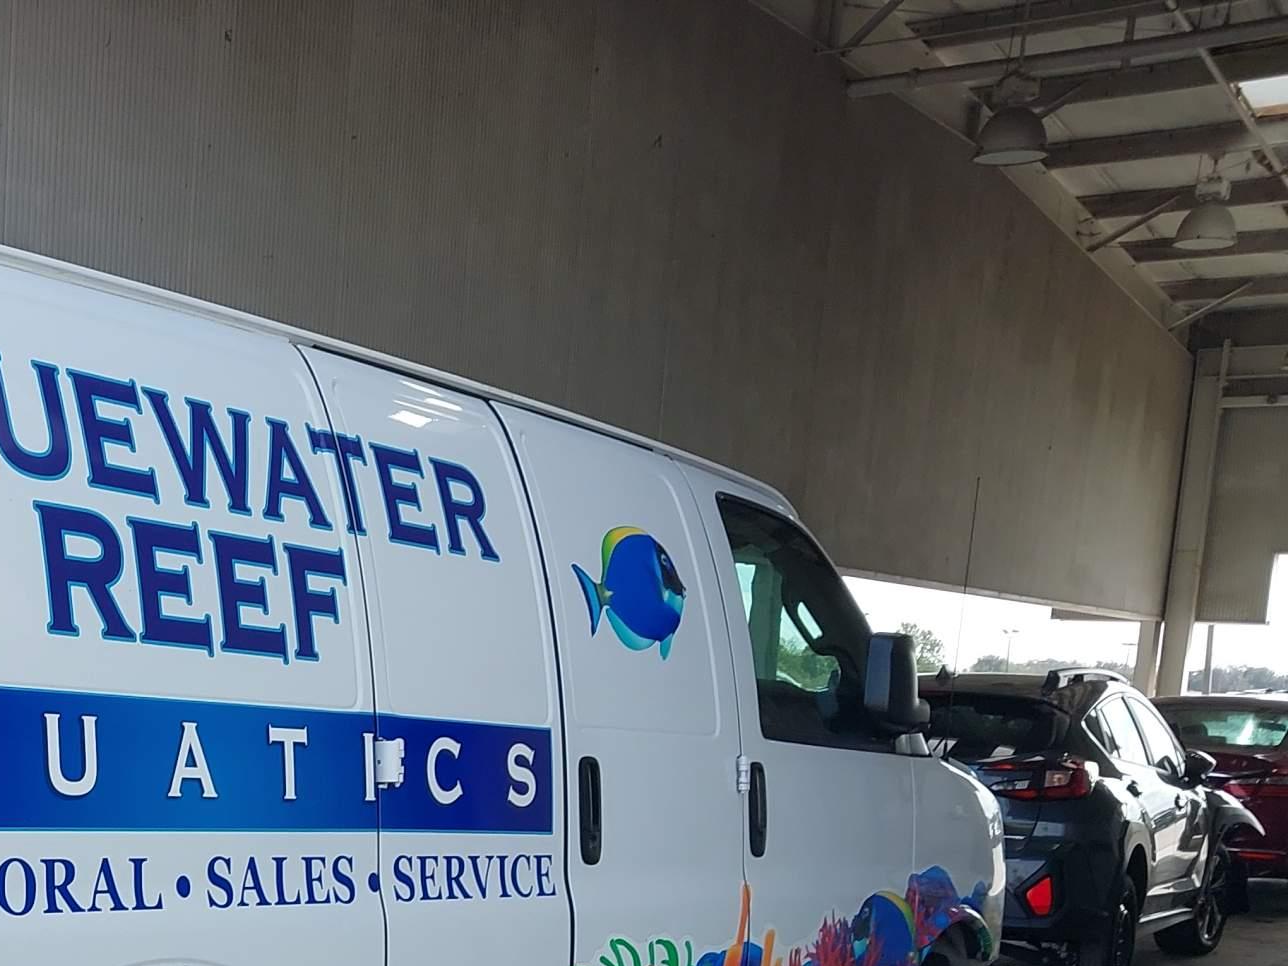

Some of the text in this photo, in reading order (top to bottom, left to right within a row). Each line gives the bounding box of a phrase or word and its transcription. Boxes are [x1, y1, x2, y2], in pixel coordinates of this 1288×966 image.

[33, 500, 347, 666] REEF
[206, 854, 357, 909] SALES
[393, 854, 557, 902] SERVICE
